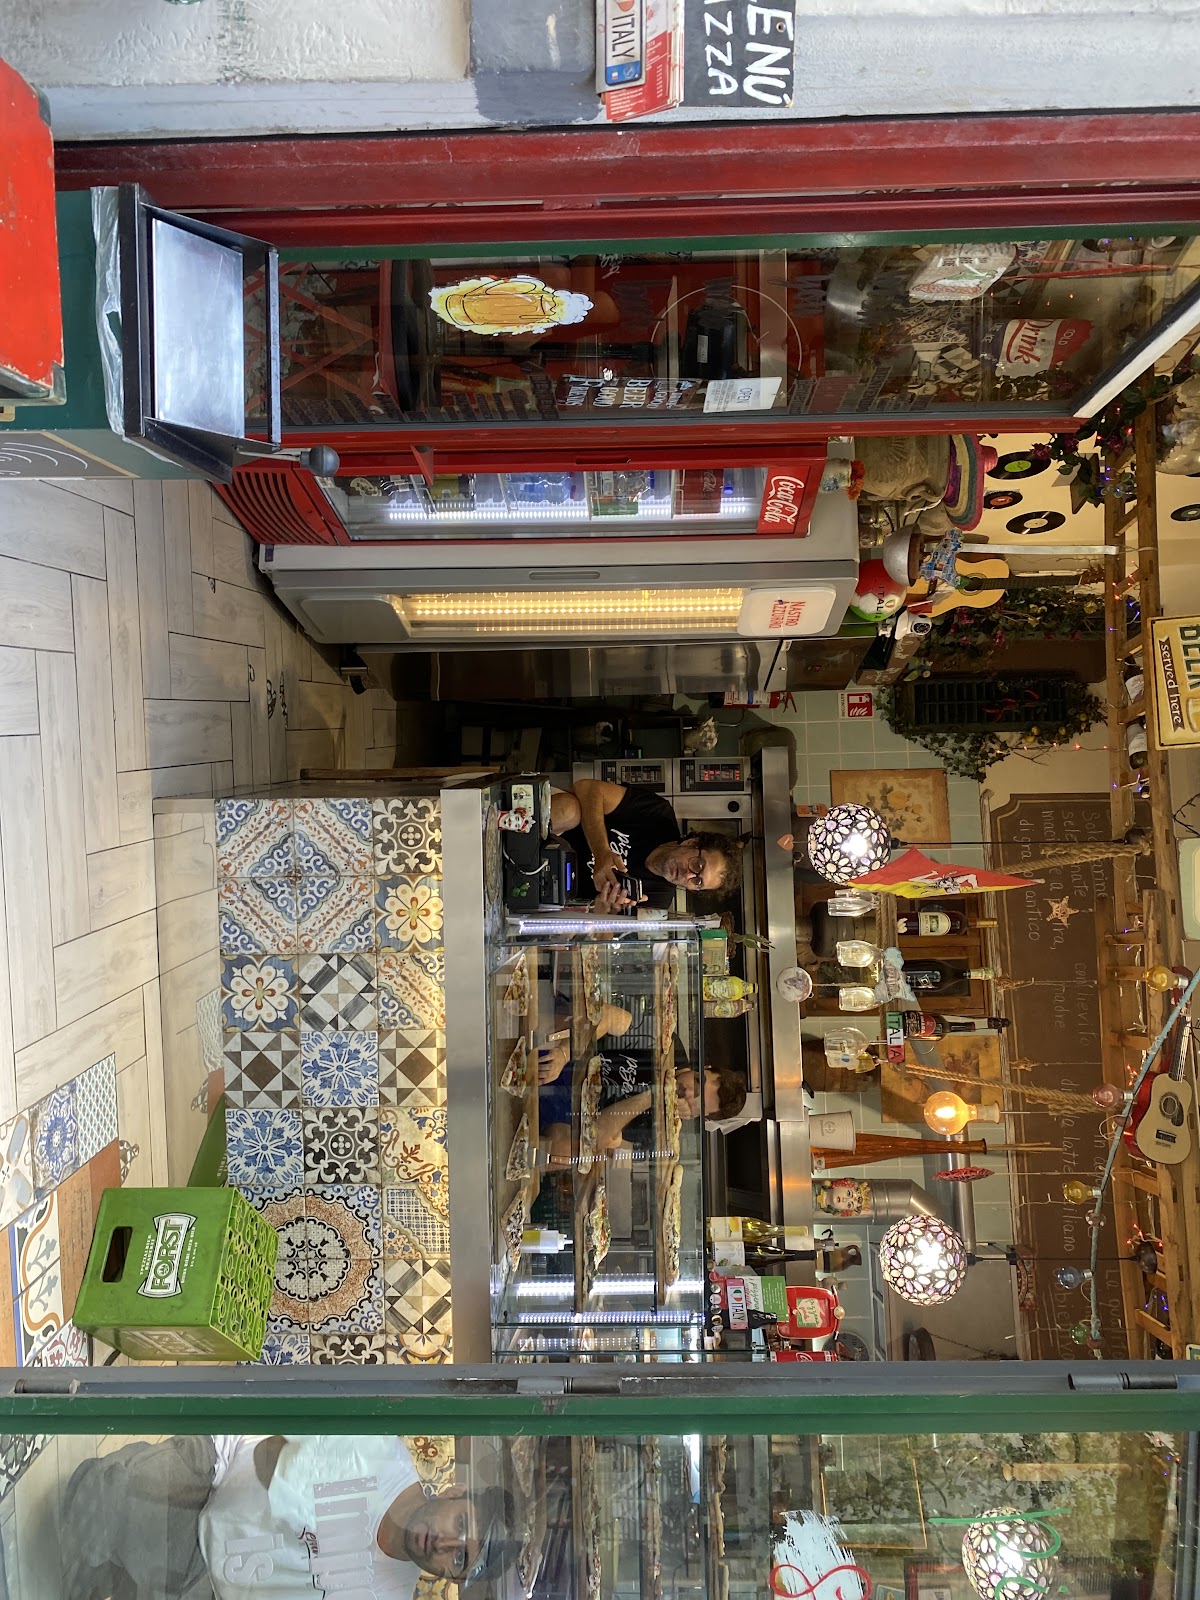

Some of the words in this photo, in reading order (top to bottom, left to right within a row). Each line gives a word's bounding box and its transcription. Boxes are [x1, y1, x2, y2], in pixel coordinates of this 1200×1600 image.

[612, 13, 635, 58] ITALY
[743, 0, 794, 104] ENÚ
[1013, 320, 1055, 364] Drink
[1058, 328, 1076, 346] COLD
[564, 376, 606, 407] FRIENDS
[592, 386, 619, 407] GOOD
[619, 379, 653, 409] BEER
[646, 391, 668, 409] GOOD
[736, 387, 753, 404] OPEN
[763, 475, 805, 525] Coca-Cola
[785, 601, 806, 627] NASTRO
[874, 586, 885, 619] ITALIA
[1160, 644, 1178, 689] served
[1169, 694, 1182, 724] here
[1019, 819, 1034, 832] di
[1012, 836, 1035, 878] grao
[1049, 883, 1064, 892] a
[1024, 890, 1043, 941] antico
[886, 1013, 904, 1062] ITALIA
[151, 1219, 183, 1290] FORST
[731, 1302, 744, 1321] ITALY
[223, 1533, 284, 1585] is
